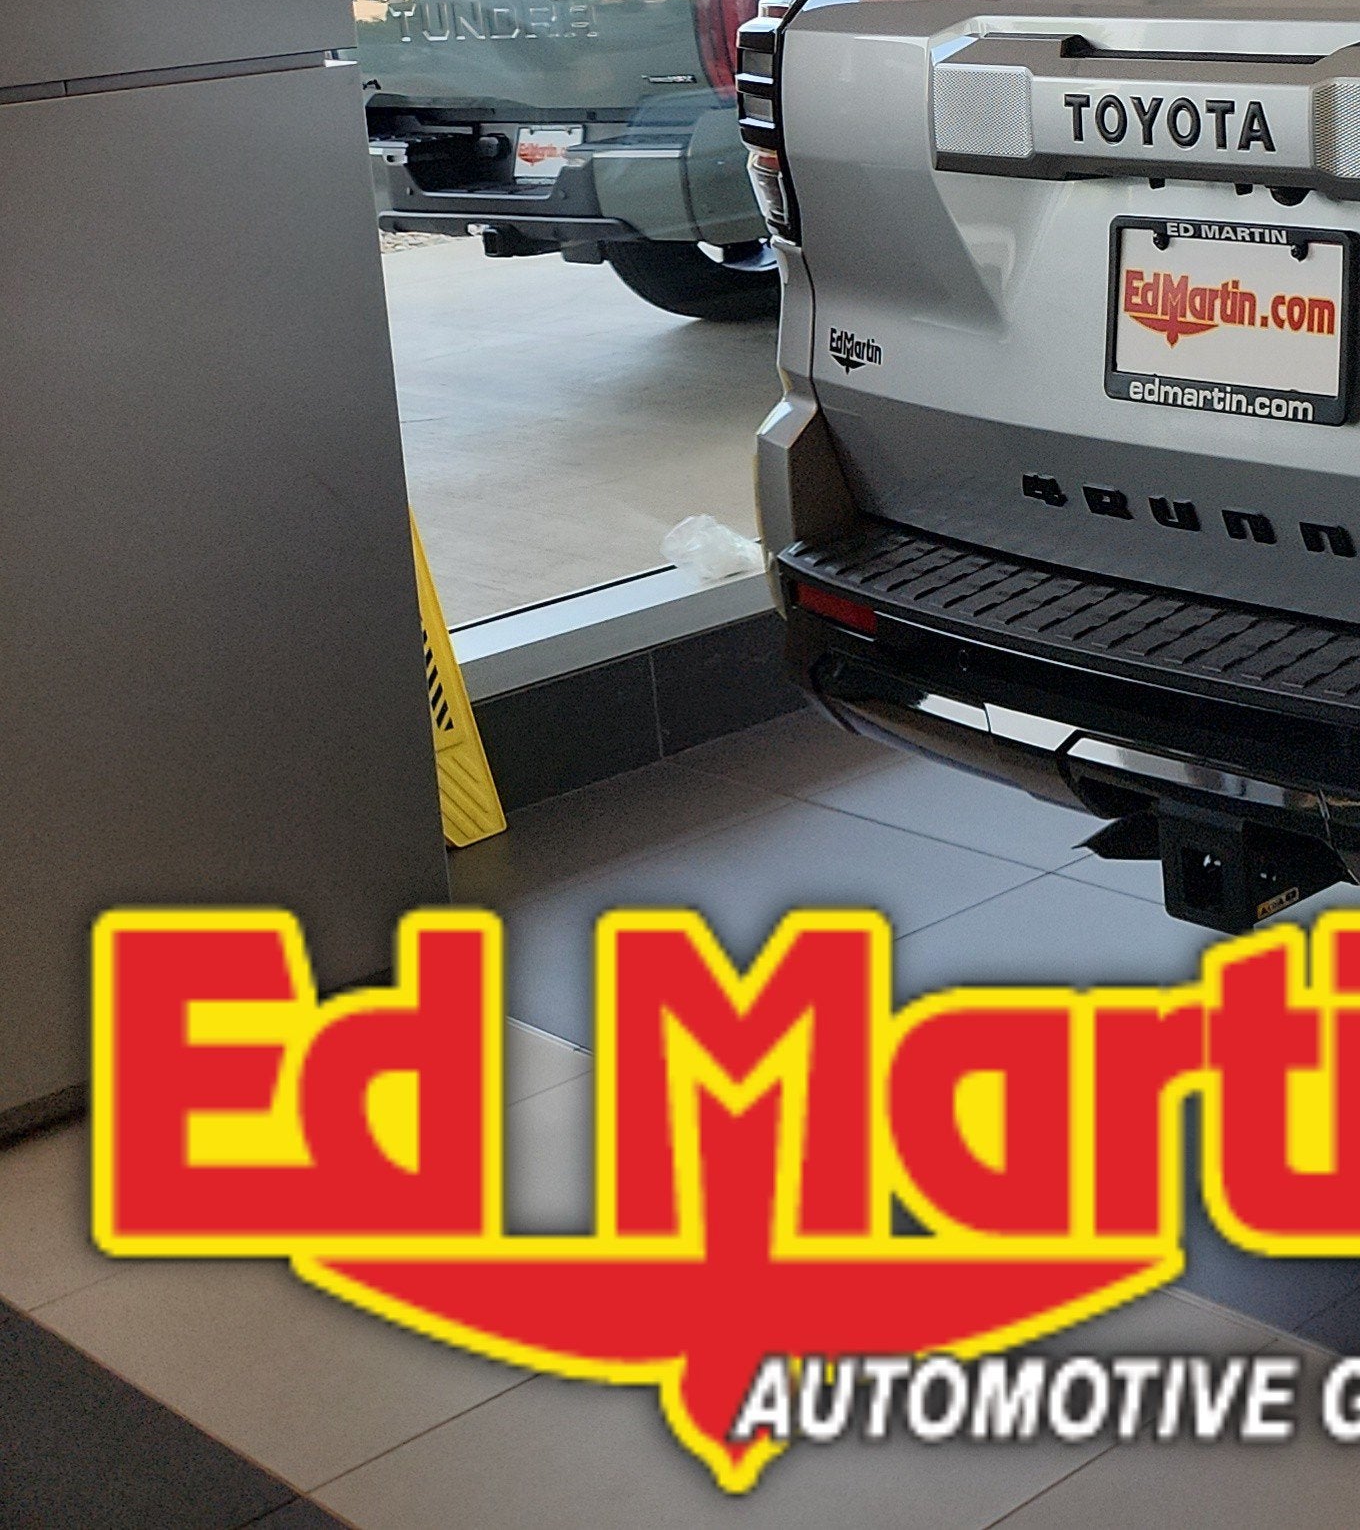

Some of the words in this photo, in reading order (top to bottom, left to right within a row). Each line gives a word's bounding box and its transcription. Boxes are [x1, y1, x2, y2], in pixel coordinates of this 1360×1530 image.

[387, 1, 601, 43] TUNDRA
[1063, 92, 1277, 153] TOYOTA
[1165, 221, 1195, 238] ED
[1200, 223, 1289, 245] MARTIN
[1122, 268, 1336, 336] EdMartin.com
[1128, 377, 1315, 422] edmartin.com
